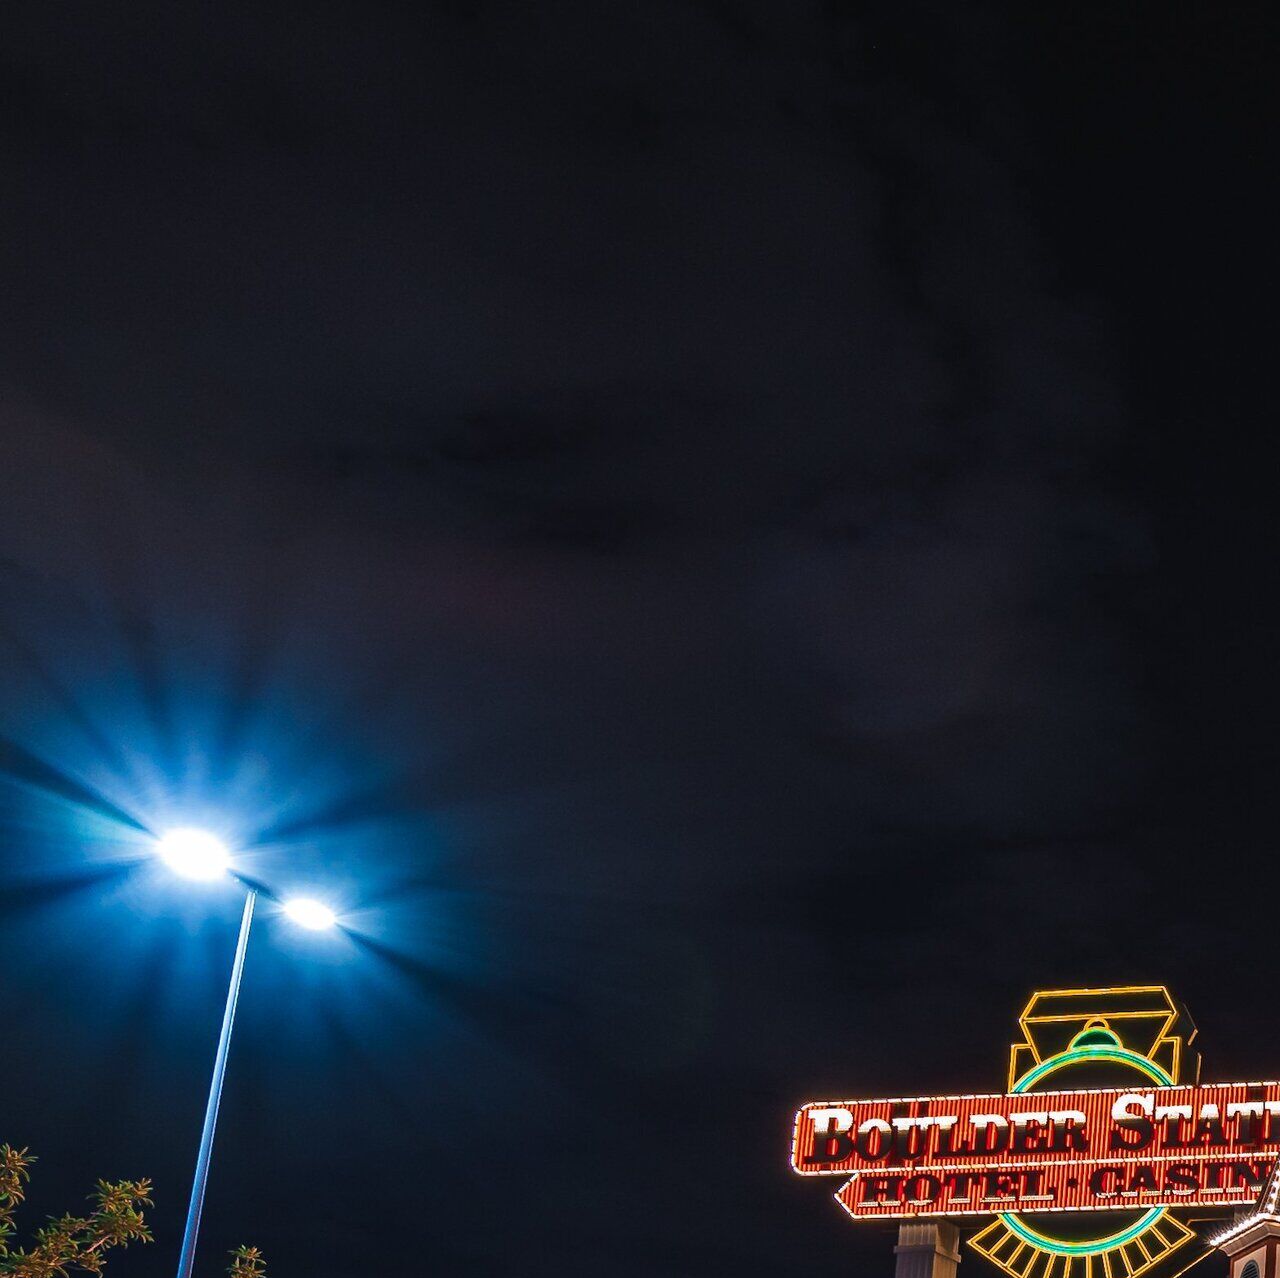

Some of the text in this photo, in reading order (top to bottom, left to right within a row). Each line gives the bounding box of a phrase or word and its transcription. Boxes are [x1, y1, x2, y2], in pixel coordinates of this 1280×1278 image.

[804, 1108, 1090, 1164] BOULDER
[857, 1162, 1270, 1207] HOTEL CASIN
